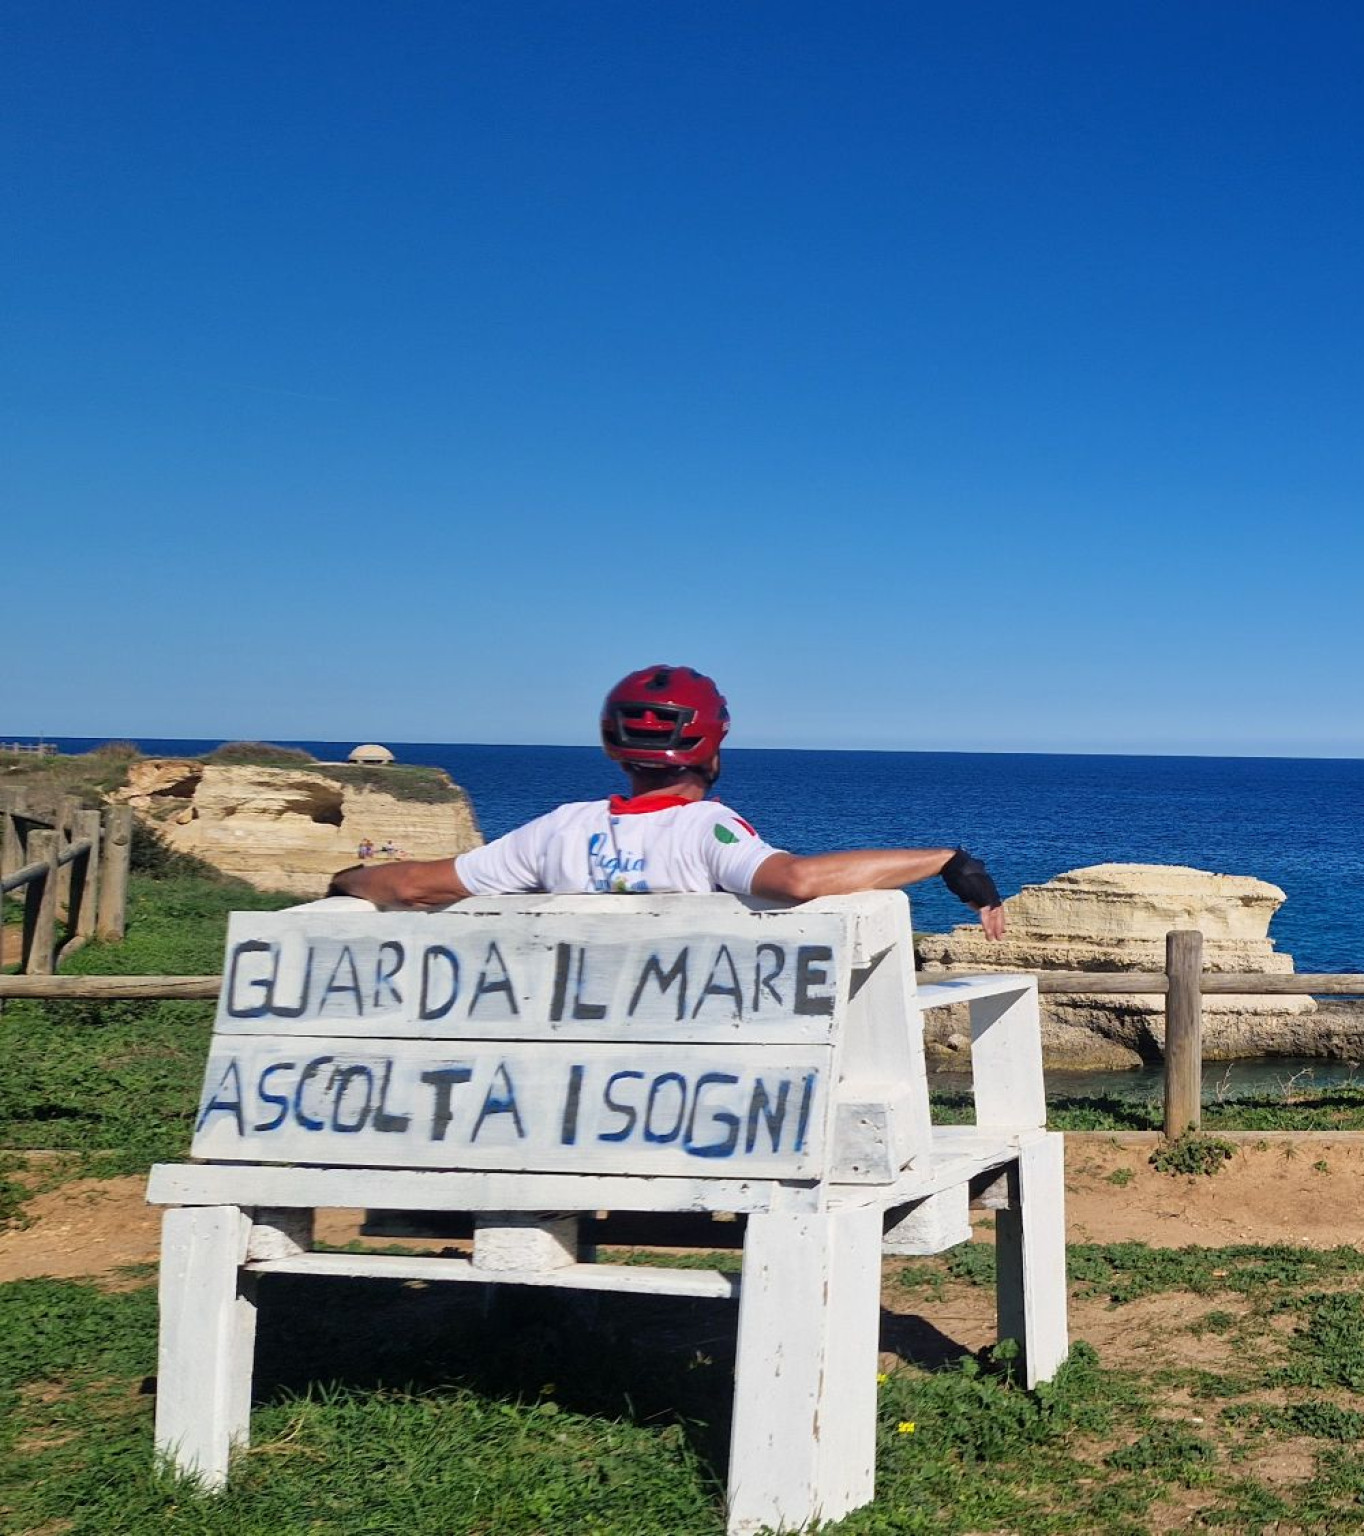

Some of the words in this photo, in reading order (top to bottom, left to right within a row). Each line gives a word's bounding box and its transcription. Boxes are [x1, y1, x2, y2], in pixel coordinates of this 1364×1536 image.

[227, 939, 520, 1020] GUARDA
[548, 942, 607, 1022] IL
[628, 943, 835, 1021] MARE
[196, 1055, 525, 1143] ASCOLTA
[560, 1065, 585, 1145] I
[598, 1070, 818, 1158] SOGNI
